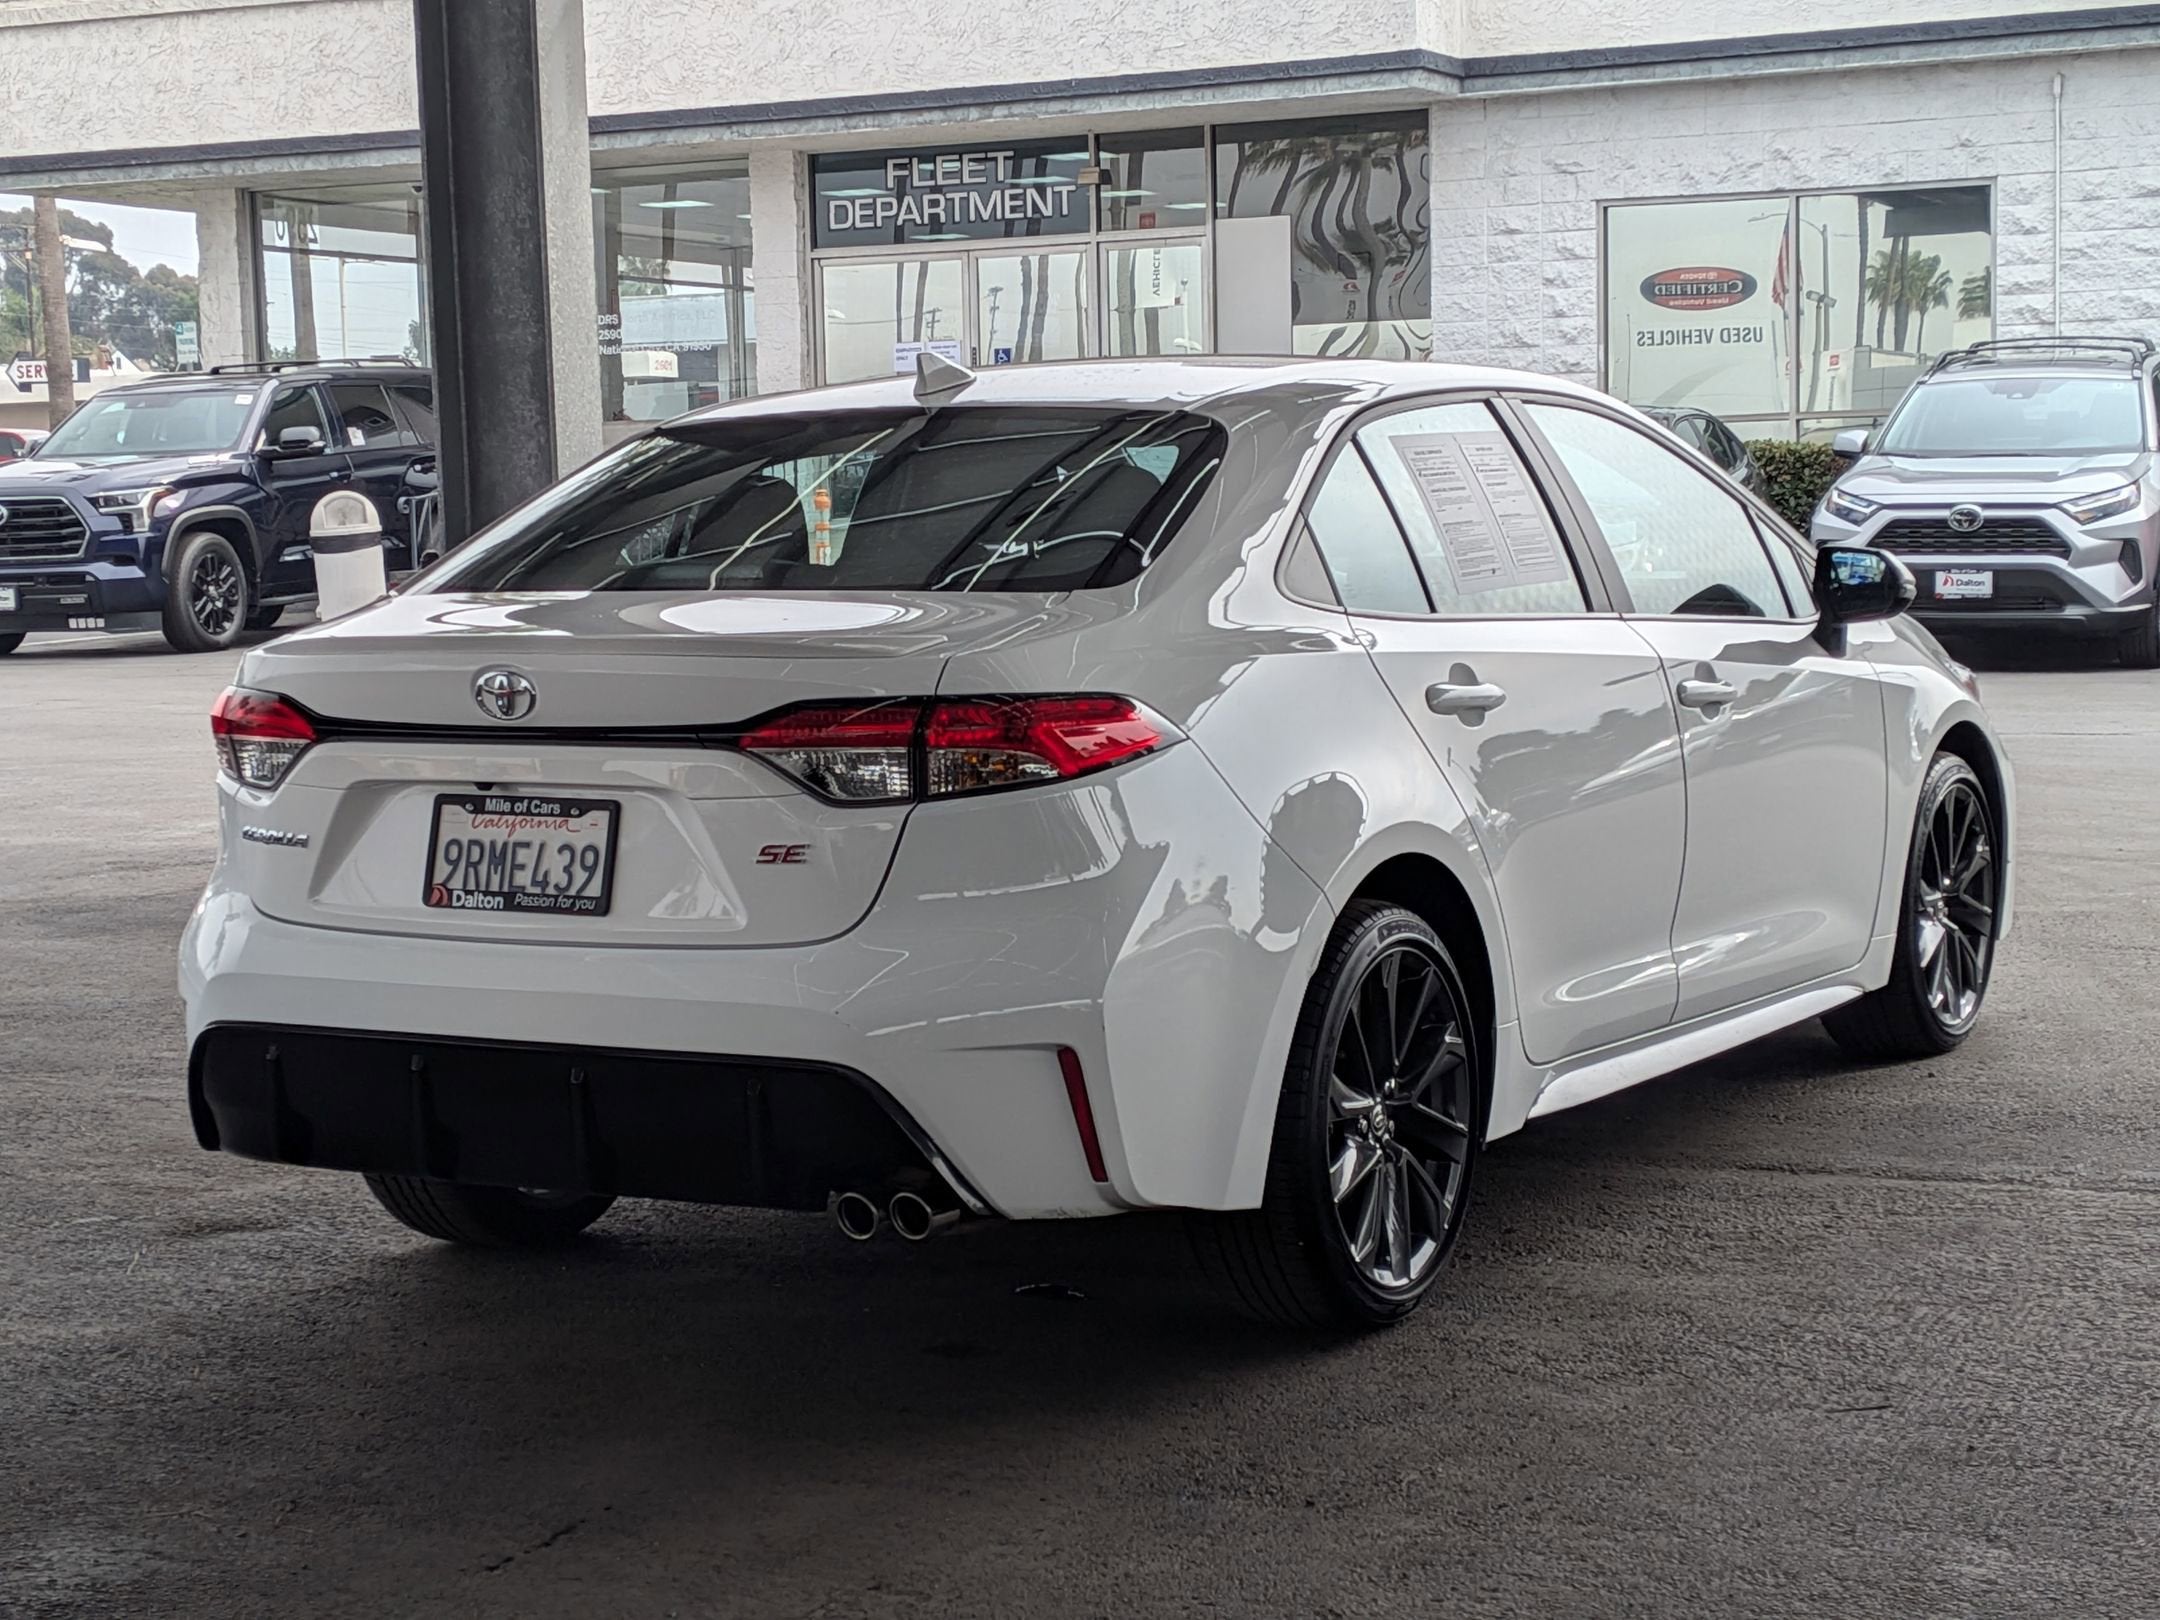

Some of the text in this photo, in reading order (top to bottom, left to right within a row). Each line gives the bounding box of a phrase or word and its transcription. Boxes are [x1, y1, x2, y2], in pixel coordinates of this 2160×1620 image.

[886, 150, 1015, 189] FLEET
[828, 184, 1077, 231] DEPARTMENT
[484, 798, 561, 815] Mile of Cars
[471, 814, 580, 838] California
[756, 844, 811, 864] SE
[442, 838, 600, 896] 9RME439
[451, 890, 597, 912] Dalton Passion for you
